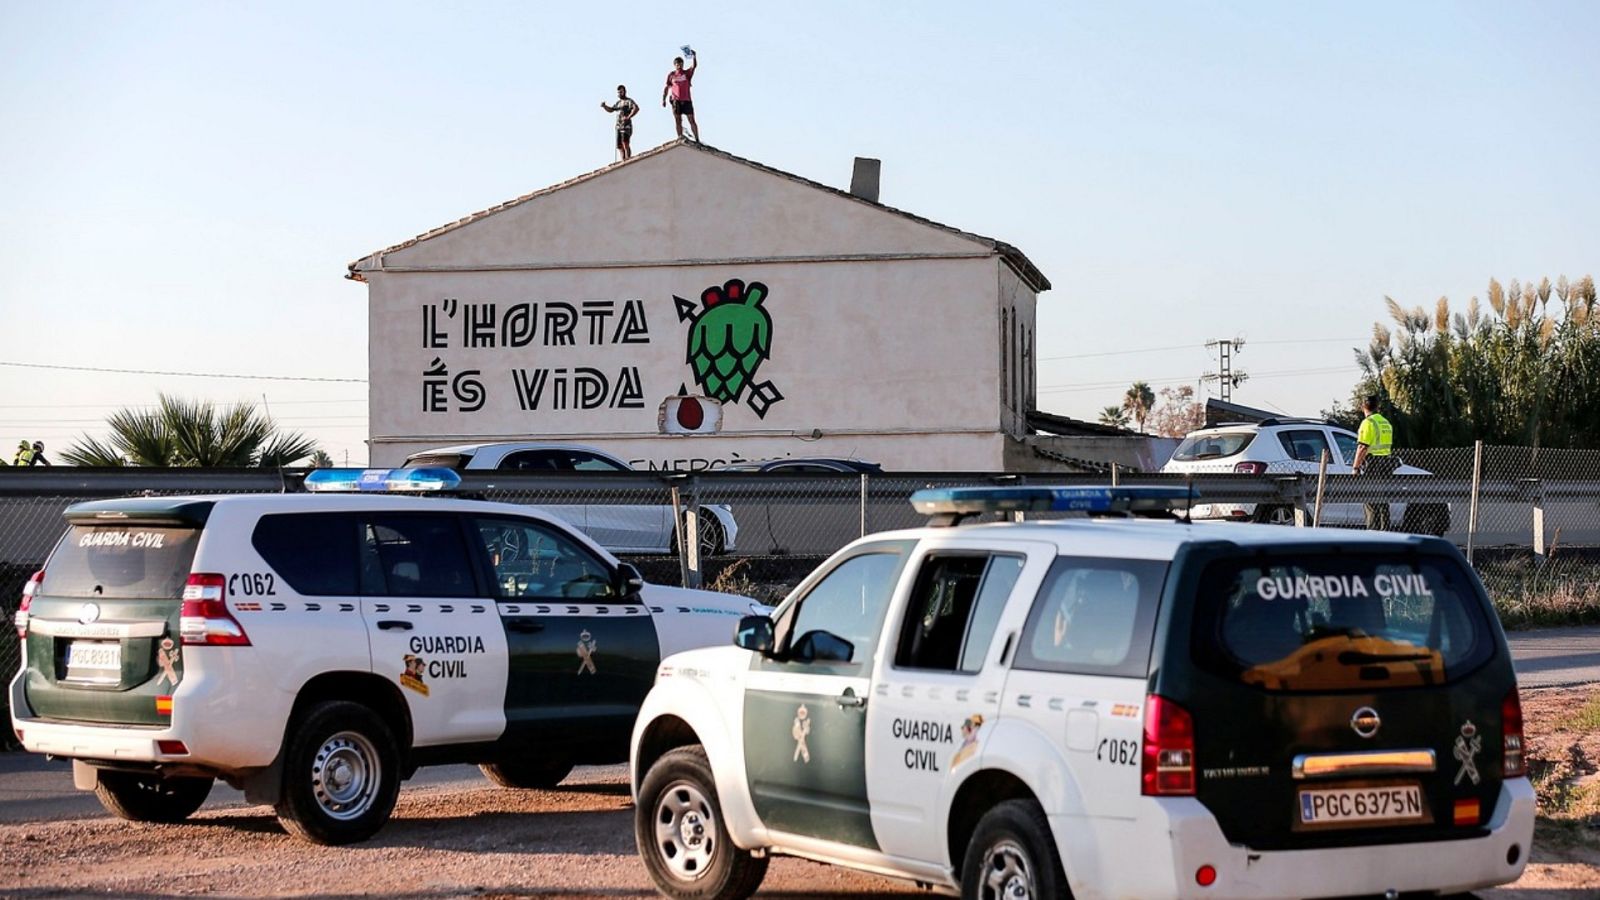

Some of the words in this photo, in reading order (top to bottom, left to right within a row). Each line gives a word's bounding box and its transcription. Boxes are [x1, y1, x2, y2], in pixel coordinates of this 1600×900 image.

[422, 299, 650, 348] L'HORTA
[422, 356, 486, 412] ÉS
[79, 531, 130, 547] GUARDIA
[132, 532, 165, 548] CIVIL
[243, 573, 276, 595] 062
[1256, 574, 1368, 600] GUARDIA
[1374, 574, 1431, 597] CIVIL
[409, 636, 485, 654] GUARDIA
[429, 660, 468, 679] CIVIL
[892, 718, 953, 744] GUARDIA
[904, 749, 939, 771] CIVIL
[1109, 740, 1138, 767] 062
